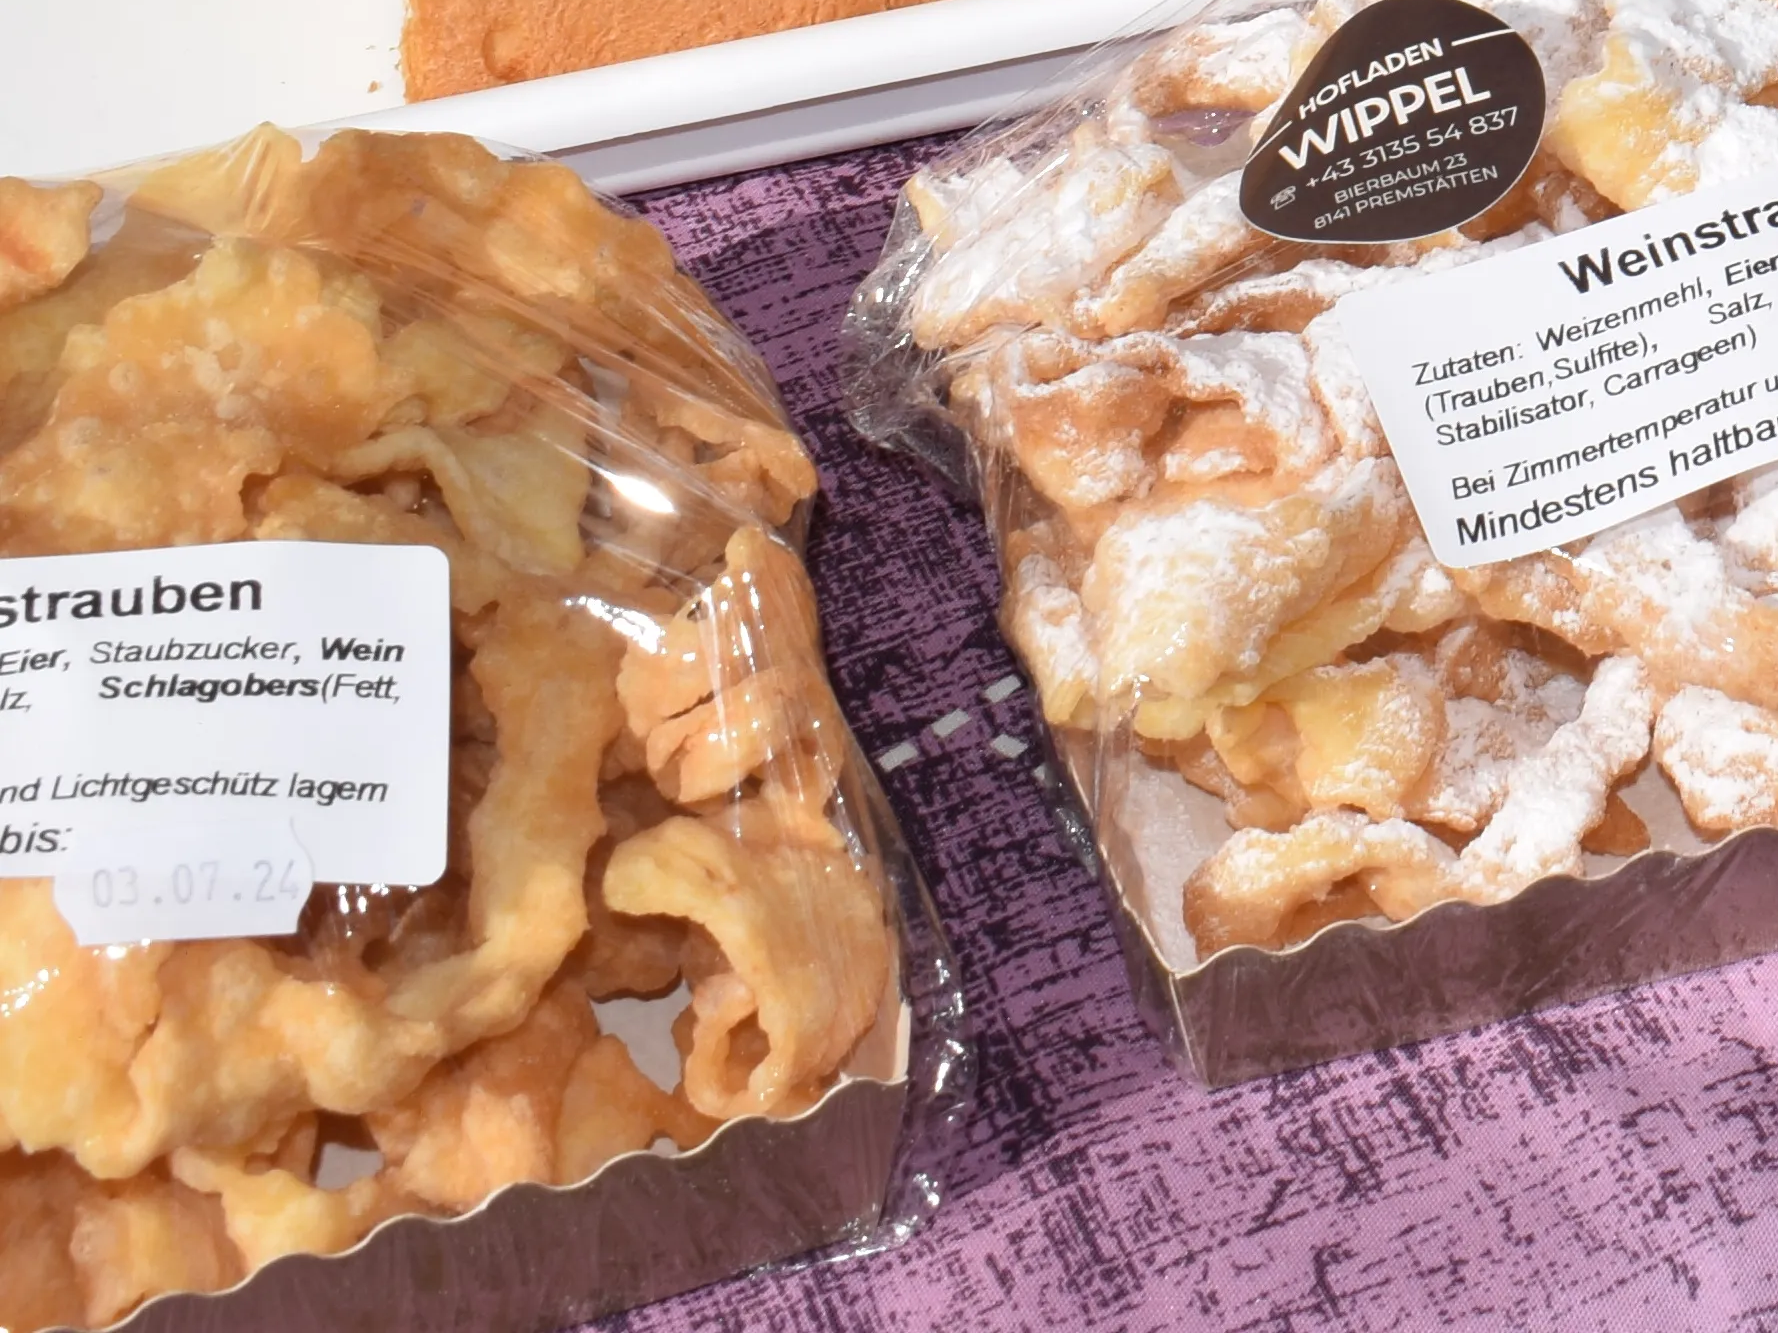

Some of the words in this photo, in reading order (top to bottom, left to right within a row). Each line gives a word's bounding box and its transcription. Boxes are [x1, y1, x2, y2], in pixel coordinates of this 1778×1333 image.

[1298, 38, 1444, 120] HOFLADEN
[1279, 67, 1491, 170] WIPPEL
[1305, 157, 1355, 188] +43
[1359, 134, 1421, 168] 3135
[1426, 123, 1463, 148] 54
[1469, 106, 1518, 134] 837
[1313, 205, 1351, 230] 8141
[1355, 165, 1499, 213] PREMSTÄTTEN
[1334, 159, 1440, 204] BIERBAUM
[1444, 152, 1468, 170] 23
[1412, 343, 1524, 386] Zutaten:
[1536, 277, 1713, 353] Weizenmehl,
[1707, 292, 1773, 325] Salz,
[1436, 388, 1595, 447] Stabilisator,
[1604, 325, 1757, 397] Carrageen)
[1451, 469, 1497, 500] Bei
[1504, 381, 1758, 488] Zimmertemperatur
[1456, 464, 1660, 546] Mindestens
[0, 575, 262, 628] strauben
[0, 648, 71, 676] Eier,
[90, 637, 301, 666] Staubzucker,
[321, 637, 405, 663] Wein
[0, 687, 32, 713] lz,
[0, 776, 42, 804] nd
[92, 859, 301, 909] 03.07.24
